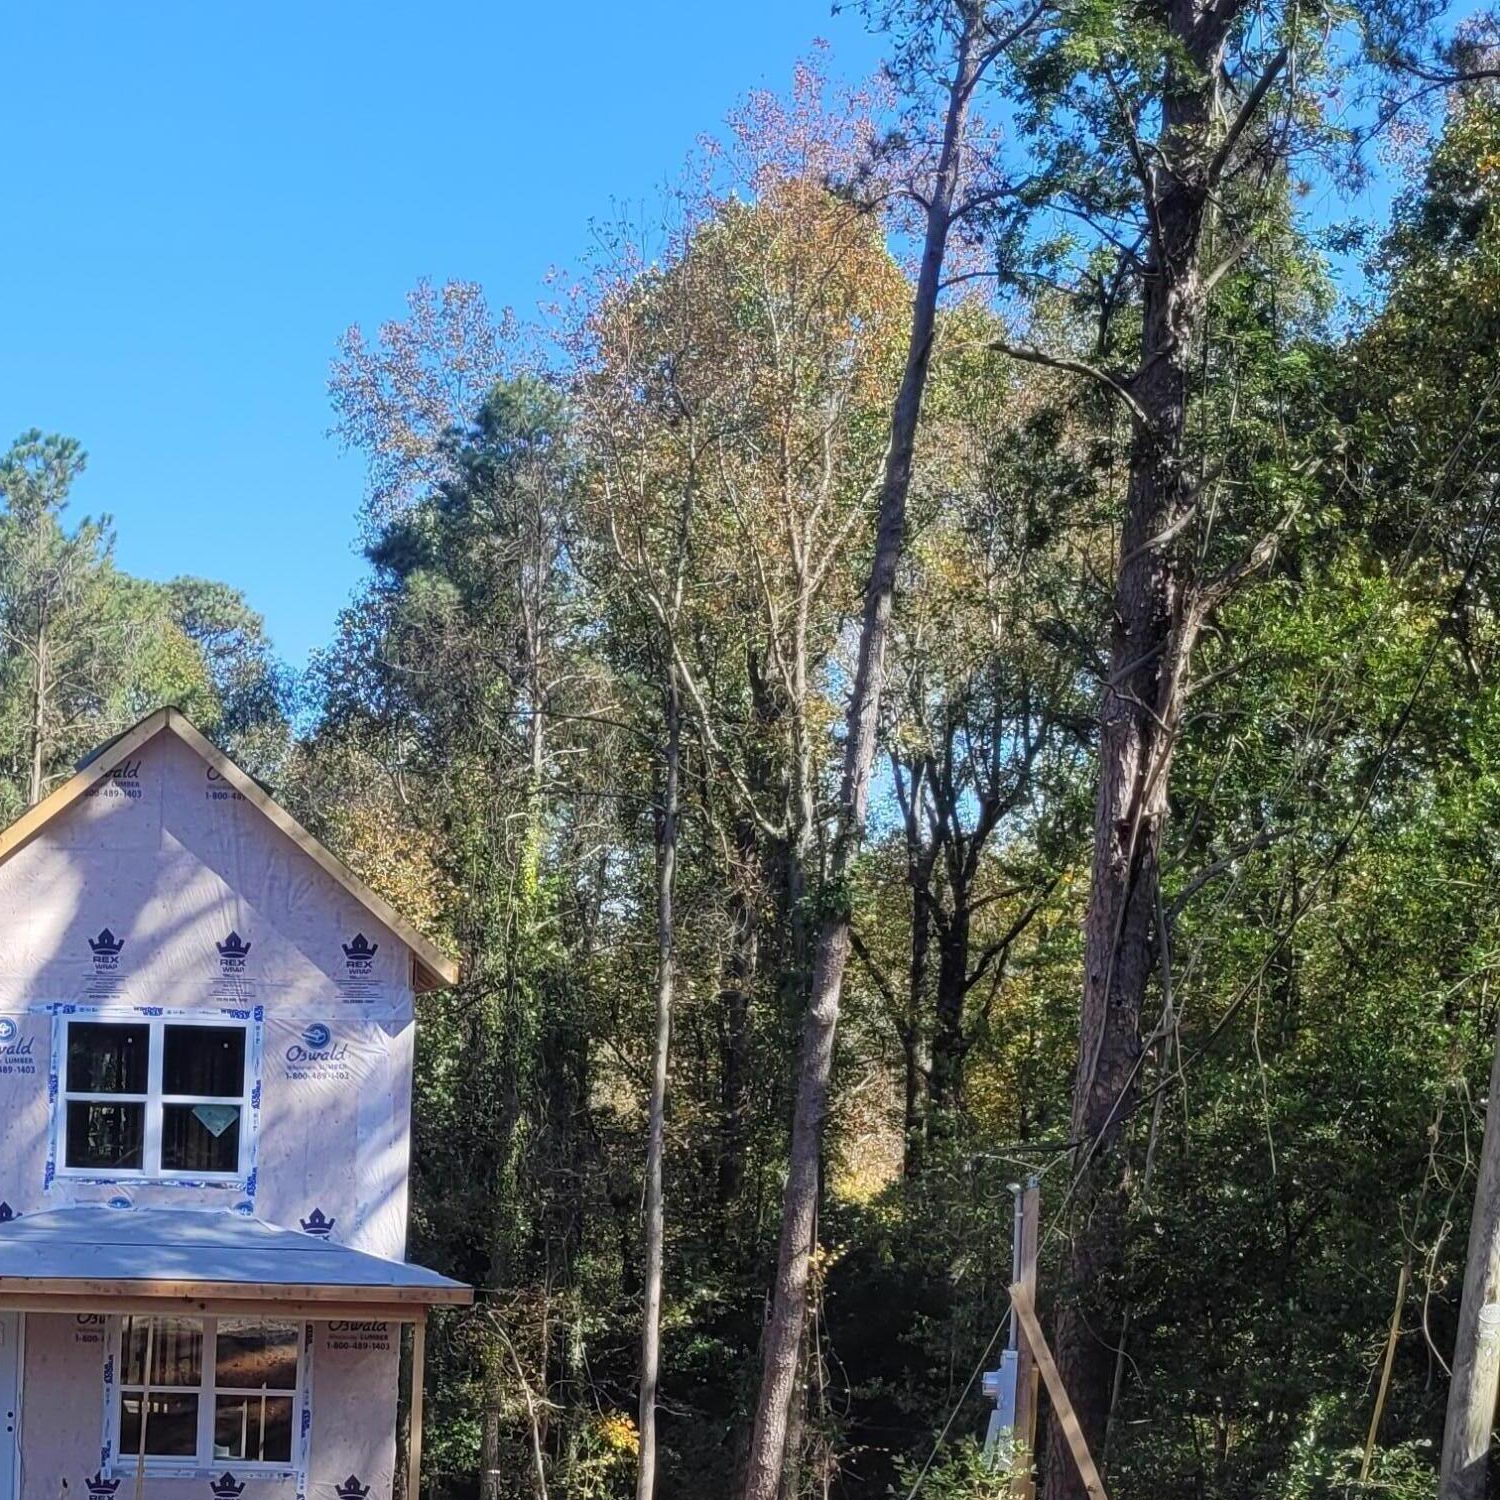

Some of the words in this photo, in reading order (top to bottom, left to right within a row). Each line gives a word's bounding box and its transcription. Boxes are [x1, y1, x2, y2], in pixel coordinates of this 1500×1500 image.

[93, 955, 119, 963] REX
[220, 959, 246, 967] REX
[346, 961, 372, 969] REX
[286, 1043, 349, 1062] Oswald
[326, 1342, 390, 1350] 1-800-489-1403
